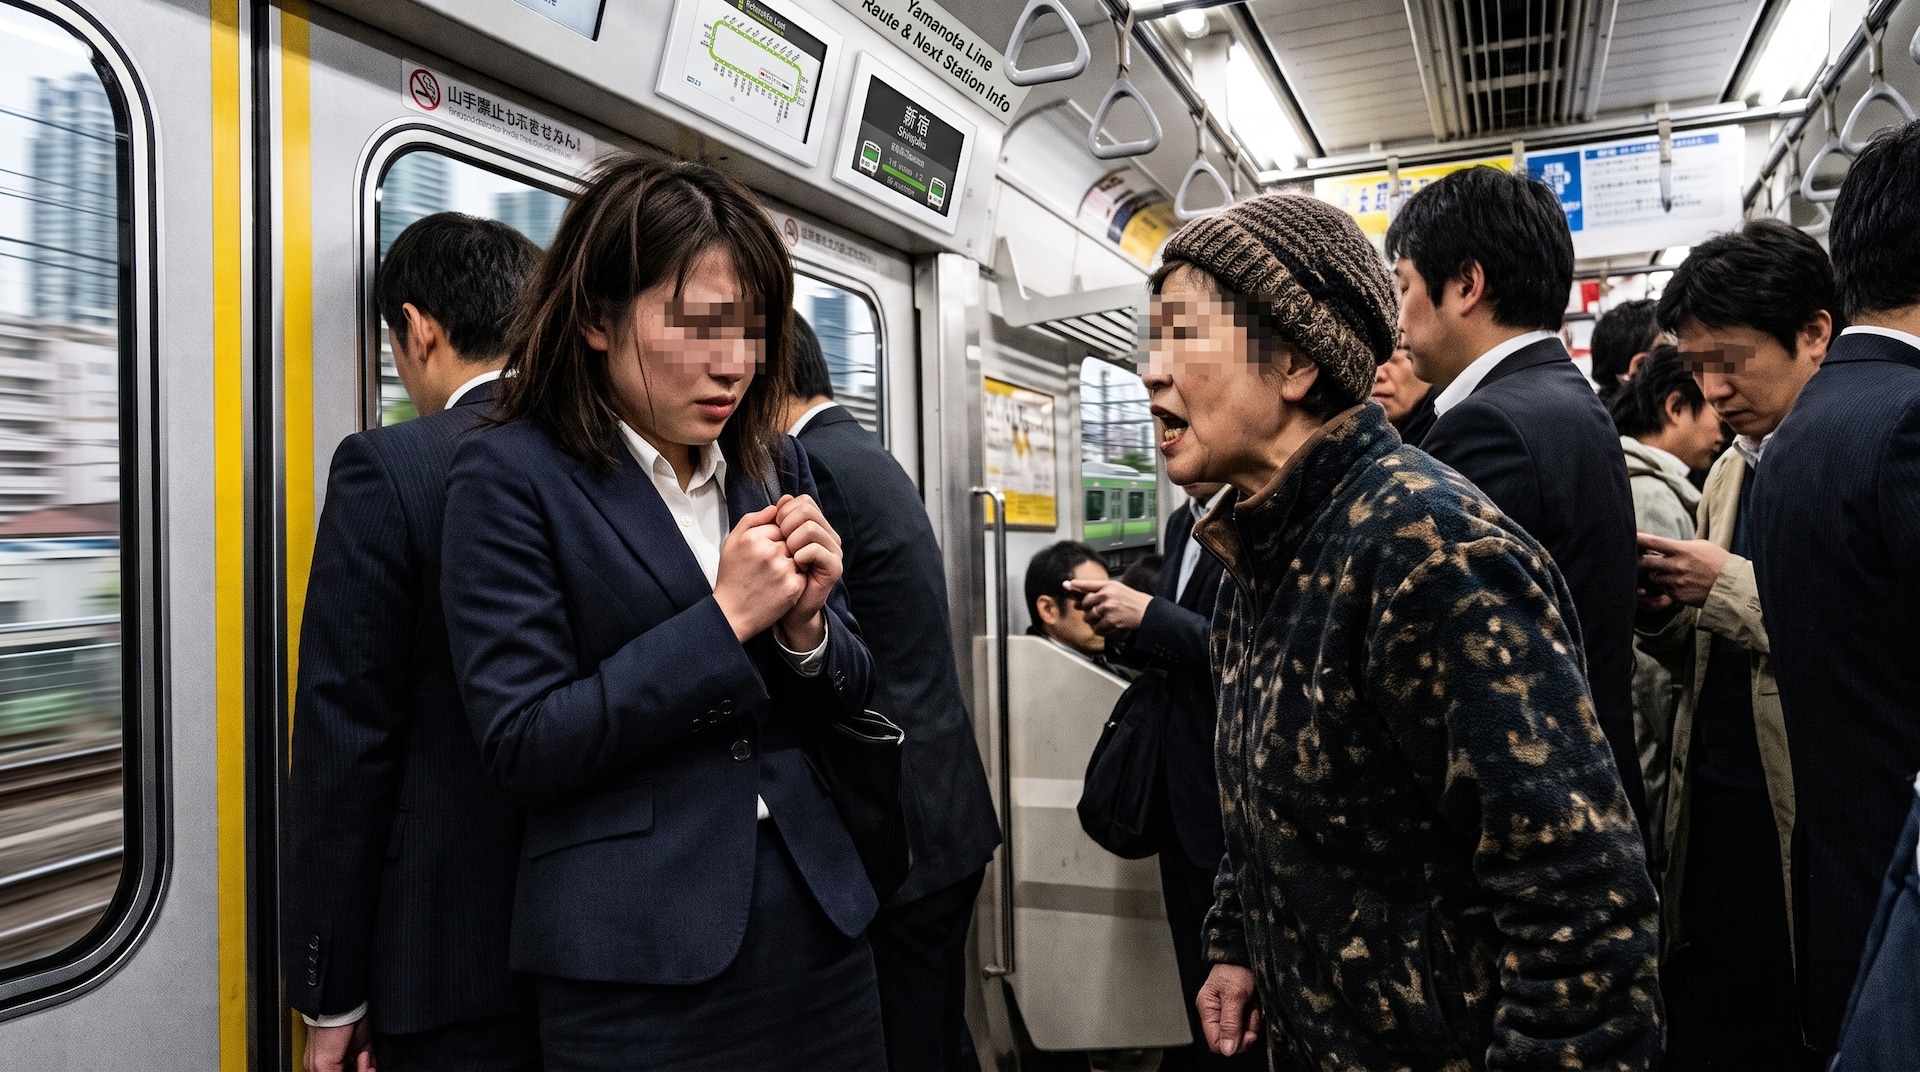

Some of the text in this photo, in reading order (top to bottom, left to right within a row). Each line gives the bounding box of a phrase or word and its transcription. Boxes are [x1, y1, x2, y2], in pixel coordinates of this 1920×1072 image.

[901, 23, 912, 40] &
[912, 31, 944, 63] Next
[943, 55, 987, 95] Station
[985, 85, 1011, 113] Info
[906, 0, 993, 71] Yamanota Line
